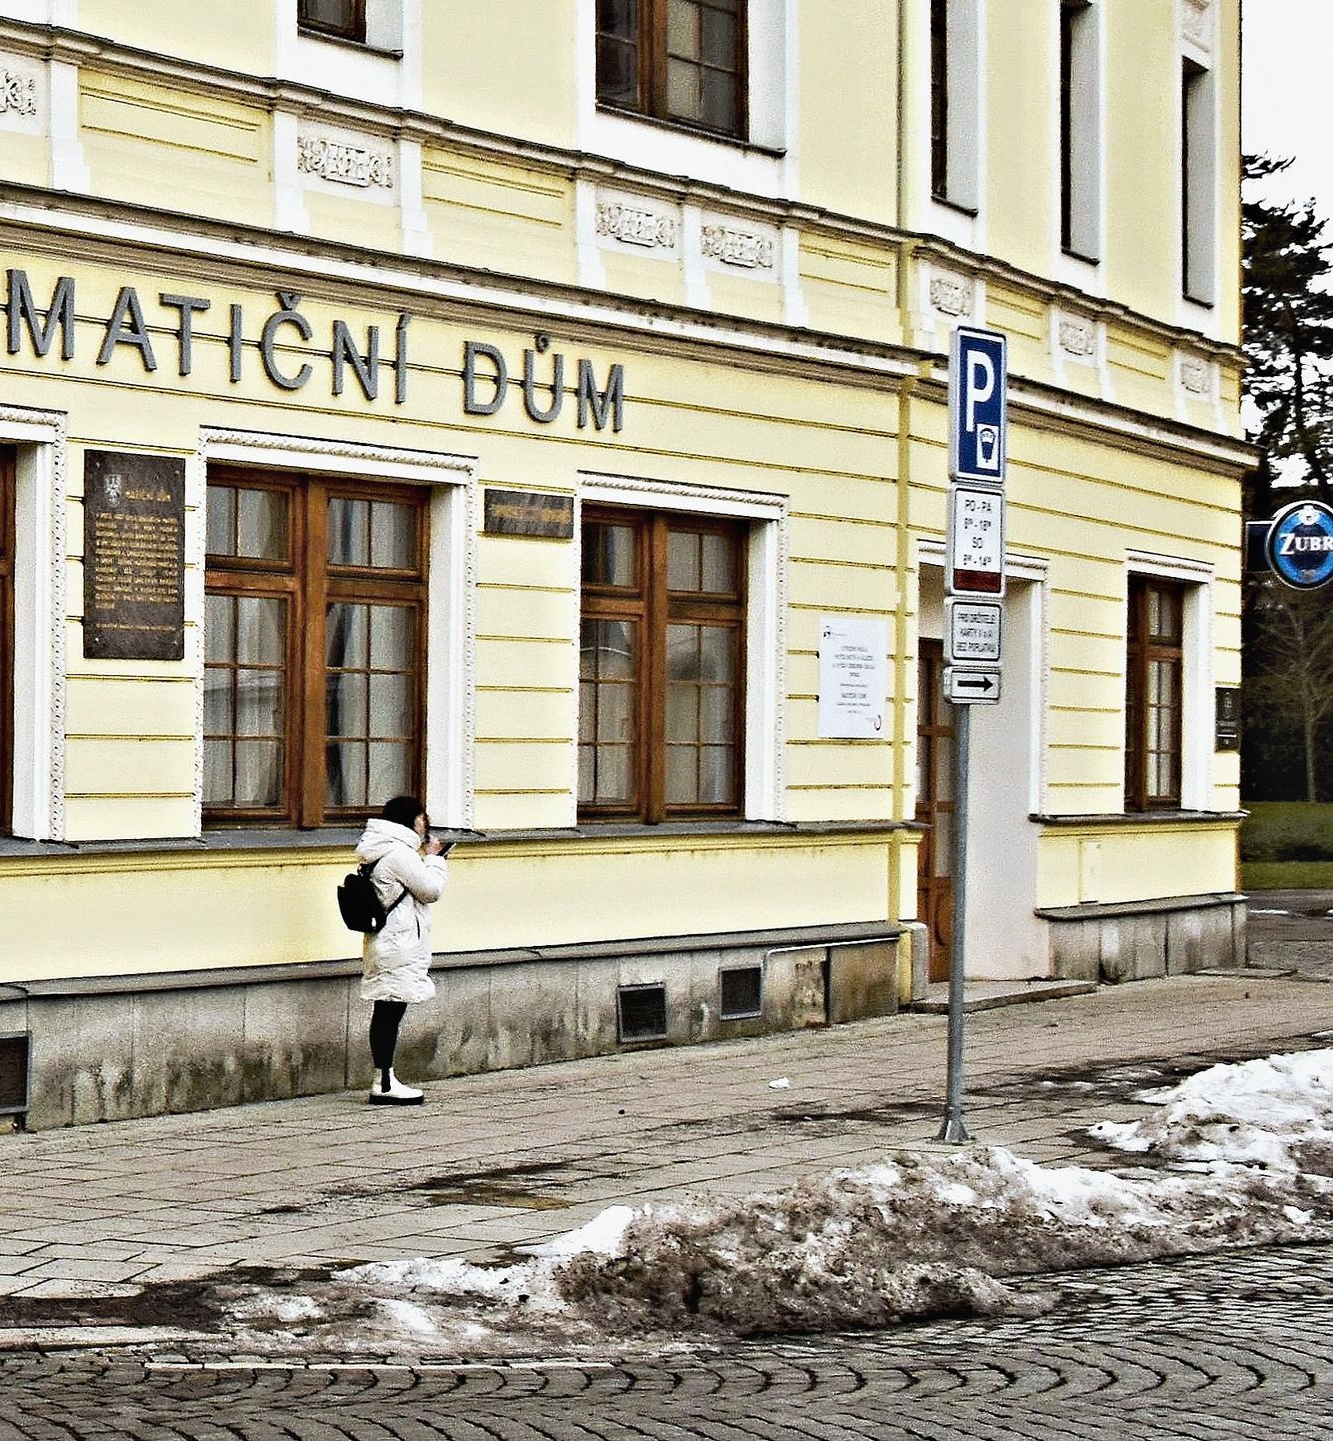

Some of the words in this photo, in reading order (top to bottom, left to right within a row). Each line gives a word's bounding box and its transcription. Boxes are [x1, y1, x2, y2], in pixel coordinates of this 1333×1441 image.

[6, 268, 413, 404] MATIČNÍ
[462, 333, 624, 433] DŮM
[966, 349, 994, 432] P
[1278, 532, 1333, 556] ZUBR
